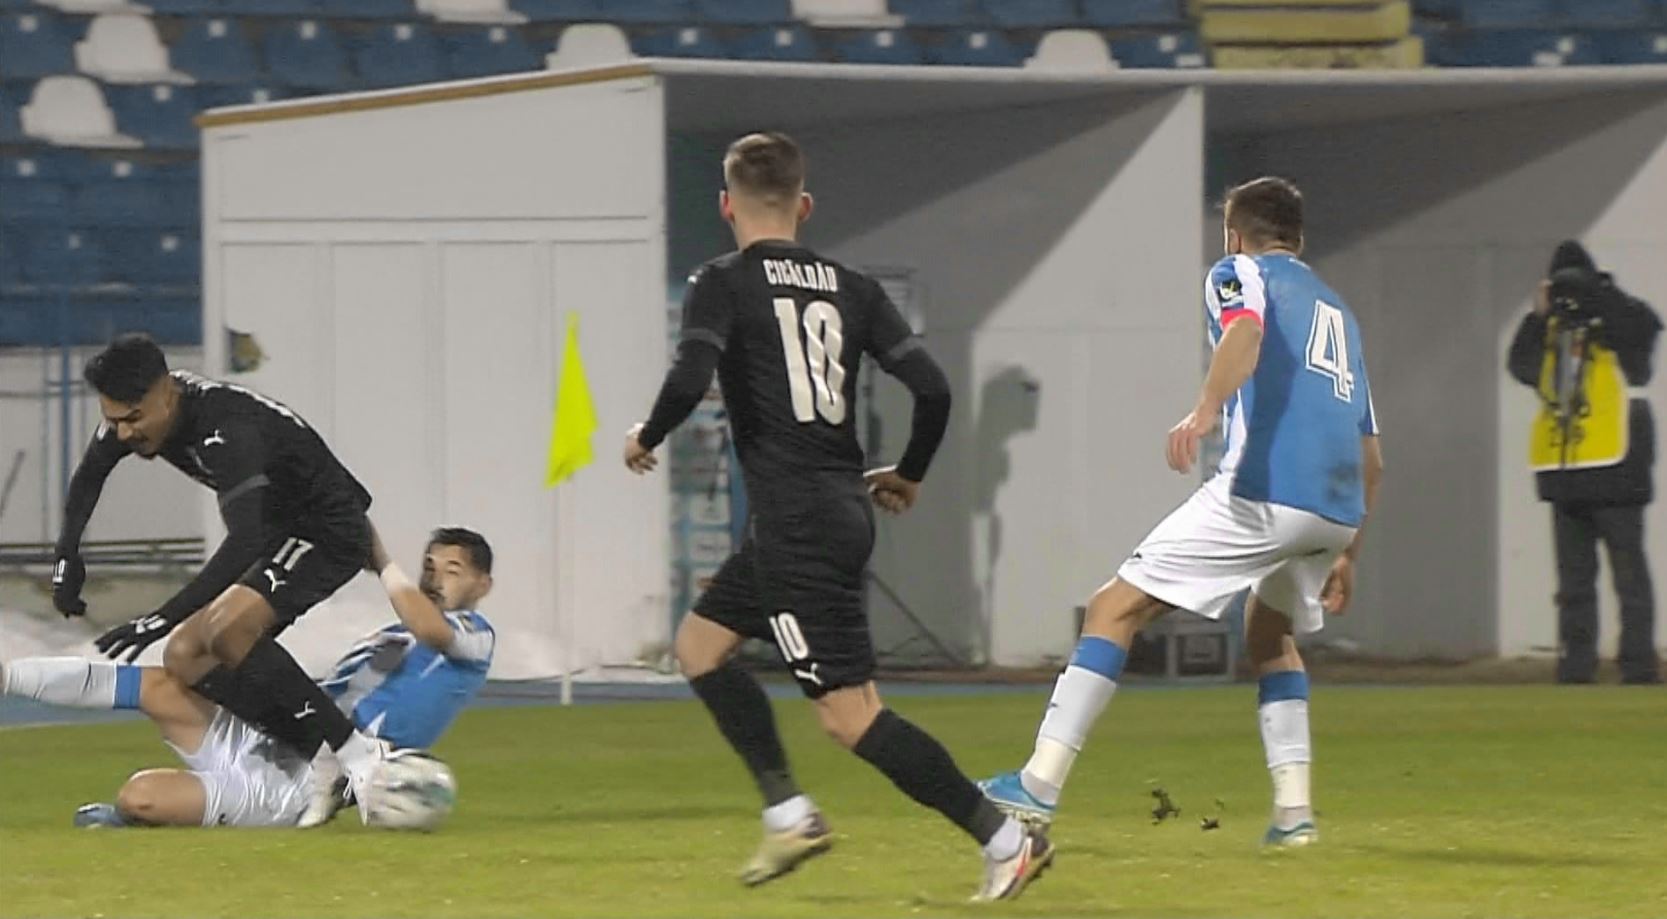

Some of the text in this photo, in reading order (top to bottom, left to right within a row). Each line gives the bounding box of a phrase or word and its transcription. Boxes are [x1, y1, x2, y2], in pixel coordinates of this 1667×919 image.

[773, 298, 846, 425] 10
[1306, 300, 1354, 403] 4
[272, 537, 314, 571] 17
[769, 612, 808, 662] 10
